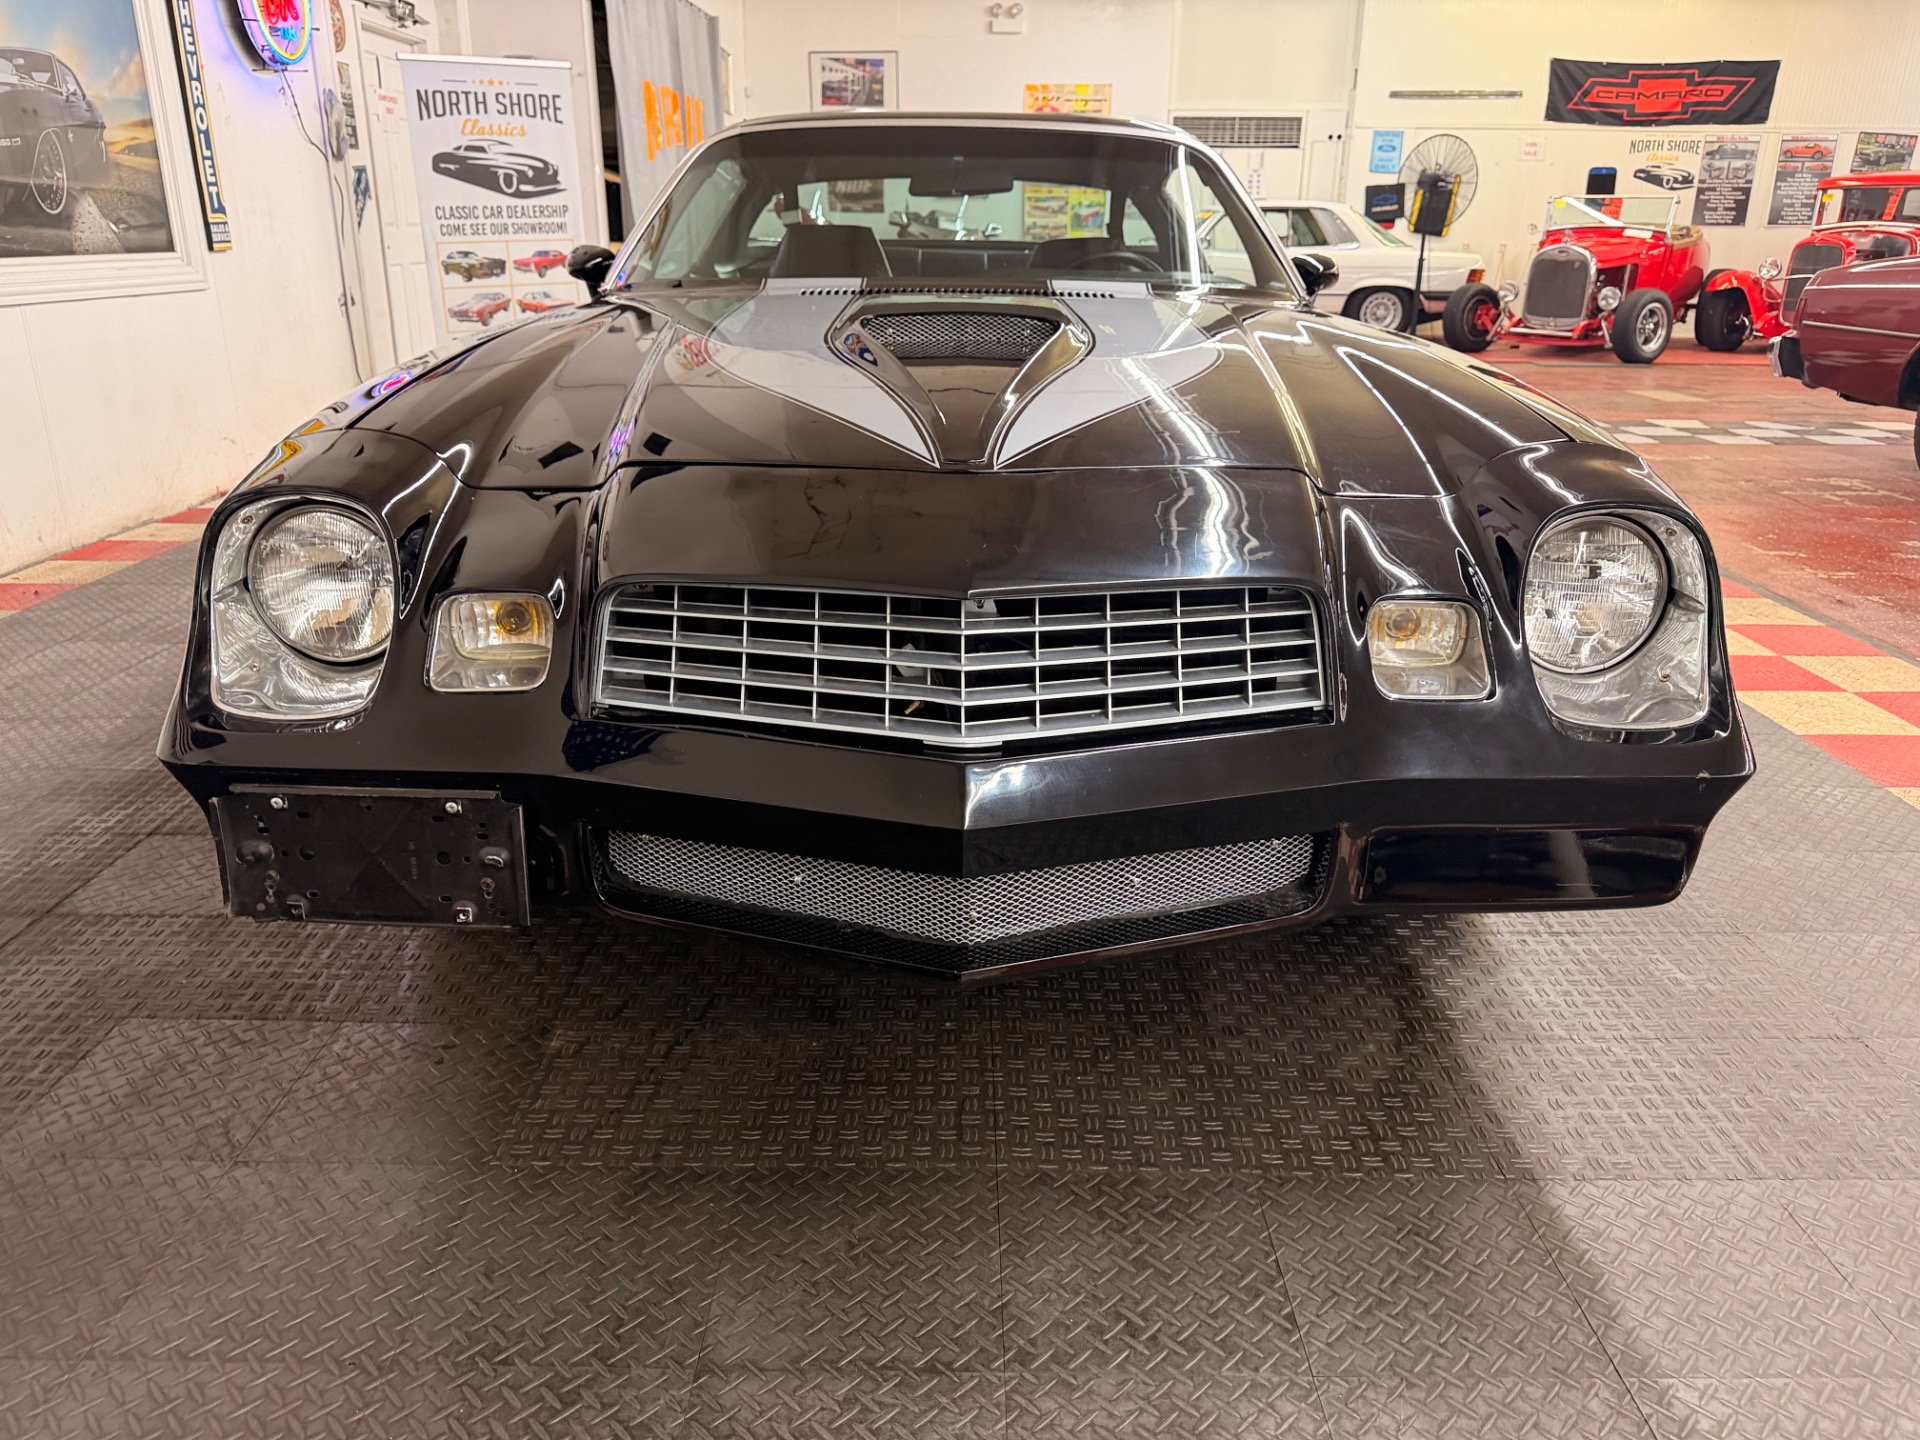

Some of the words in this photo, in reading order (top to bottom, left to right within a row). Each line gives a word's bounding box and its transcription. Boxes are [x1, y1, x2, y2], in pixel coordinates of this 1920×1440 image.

[1596, 88, 1724, 100] CAMARO
[179, 0, 218, 209] HEVROLET
[416, 89, 488, 121] NORTH
[495, 92, 564, 124] SHORE
[460, 118, 527, 137] Classics
[1629, 139, 1665, 154] NORTH
[1667, 139, 1702, 155] SHORE
[1645, 152, 1680, 161] Classics
[435, 205, 479, 220] CLASSIC
[482, 205, 504, 219] CAR
[506, 204, 569, 219] DEALERSHIP
[210, 223, 225, 232] SALES
[440, 223, 467, 236] COME
[470, 223, 487, 235] SEE
[490, 223, 510, 235] OUR
[511, 222, 568, 235] SHOWROOM!
